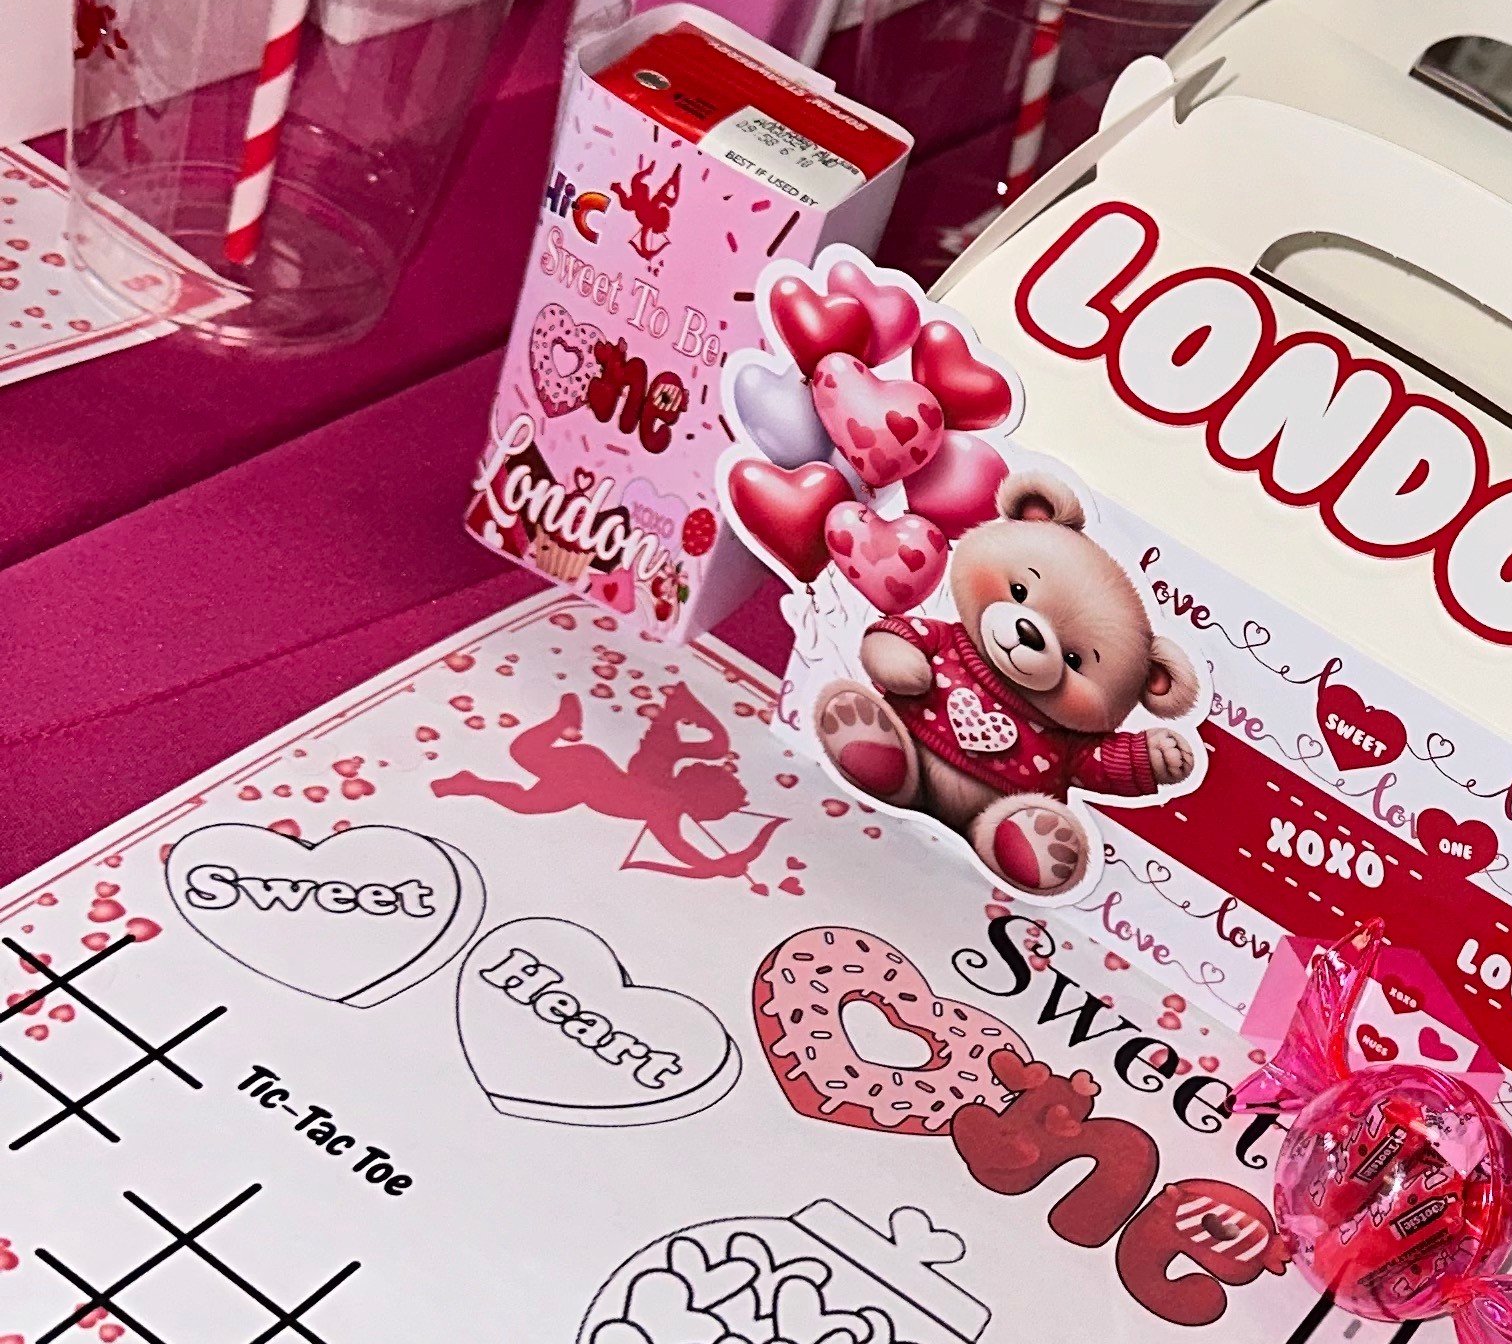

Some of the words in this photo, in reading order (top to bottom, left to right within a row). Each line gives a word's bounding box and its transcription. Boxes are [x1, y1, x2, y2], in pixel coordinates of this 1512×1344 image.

[724, 150, 753, 172] BEST
[755, 166, 767, 177] IF
[768, 171, 799, 196] USED
[800, 193, 819, 207] BY
[540, 225, 623, 315] Sweet
[626, 277, 671, 339] To
[671, 305, 721, 367] Be
[472, 413, 667, 578] London
[1325, 713, 1387, 758] SWEET
[1266, 816, 1385, 889] XOXO
[1438, 837, 1473, 861] ONE
[185, 863, 438, 919] Sweet
[1102, 891, 1171, 966] love
[479, 947, 684, 1090] Heart
[1388, 986, 1418, 1009] XOXO
[950, 912, 1290, 1171] Sweet
[1361, 1034, 1388, 1057] HUGS
[236, 1064, 354, 1158] Tic-Tac
[351, 1147, 414, 1198] Toe
